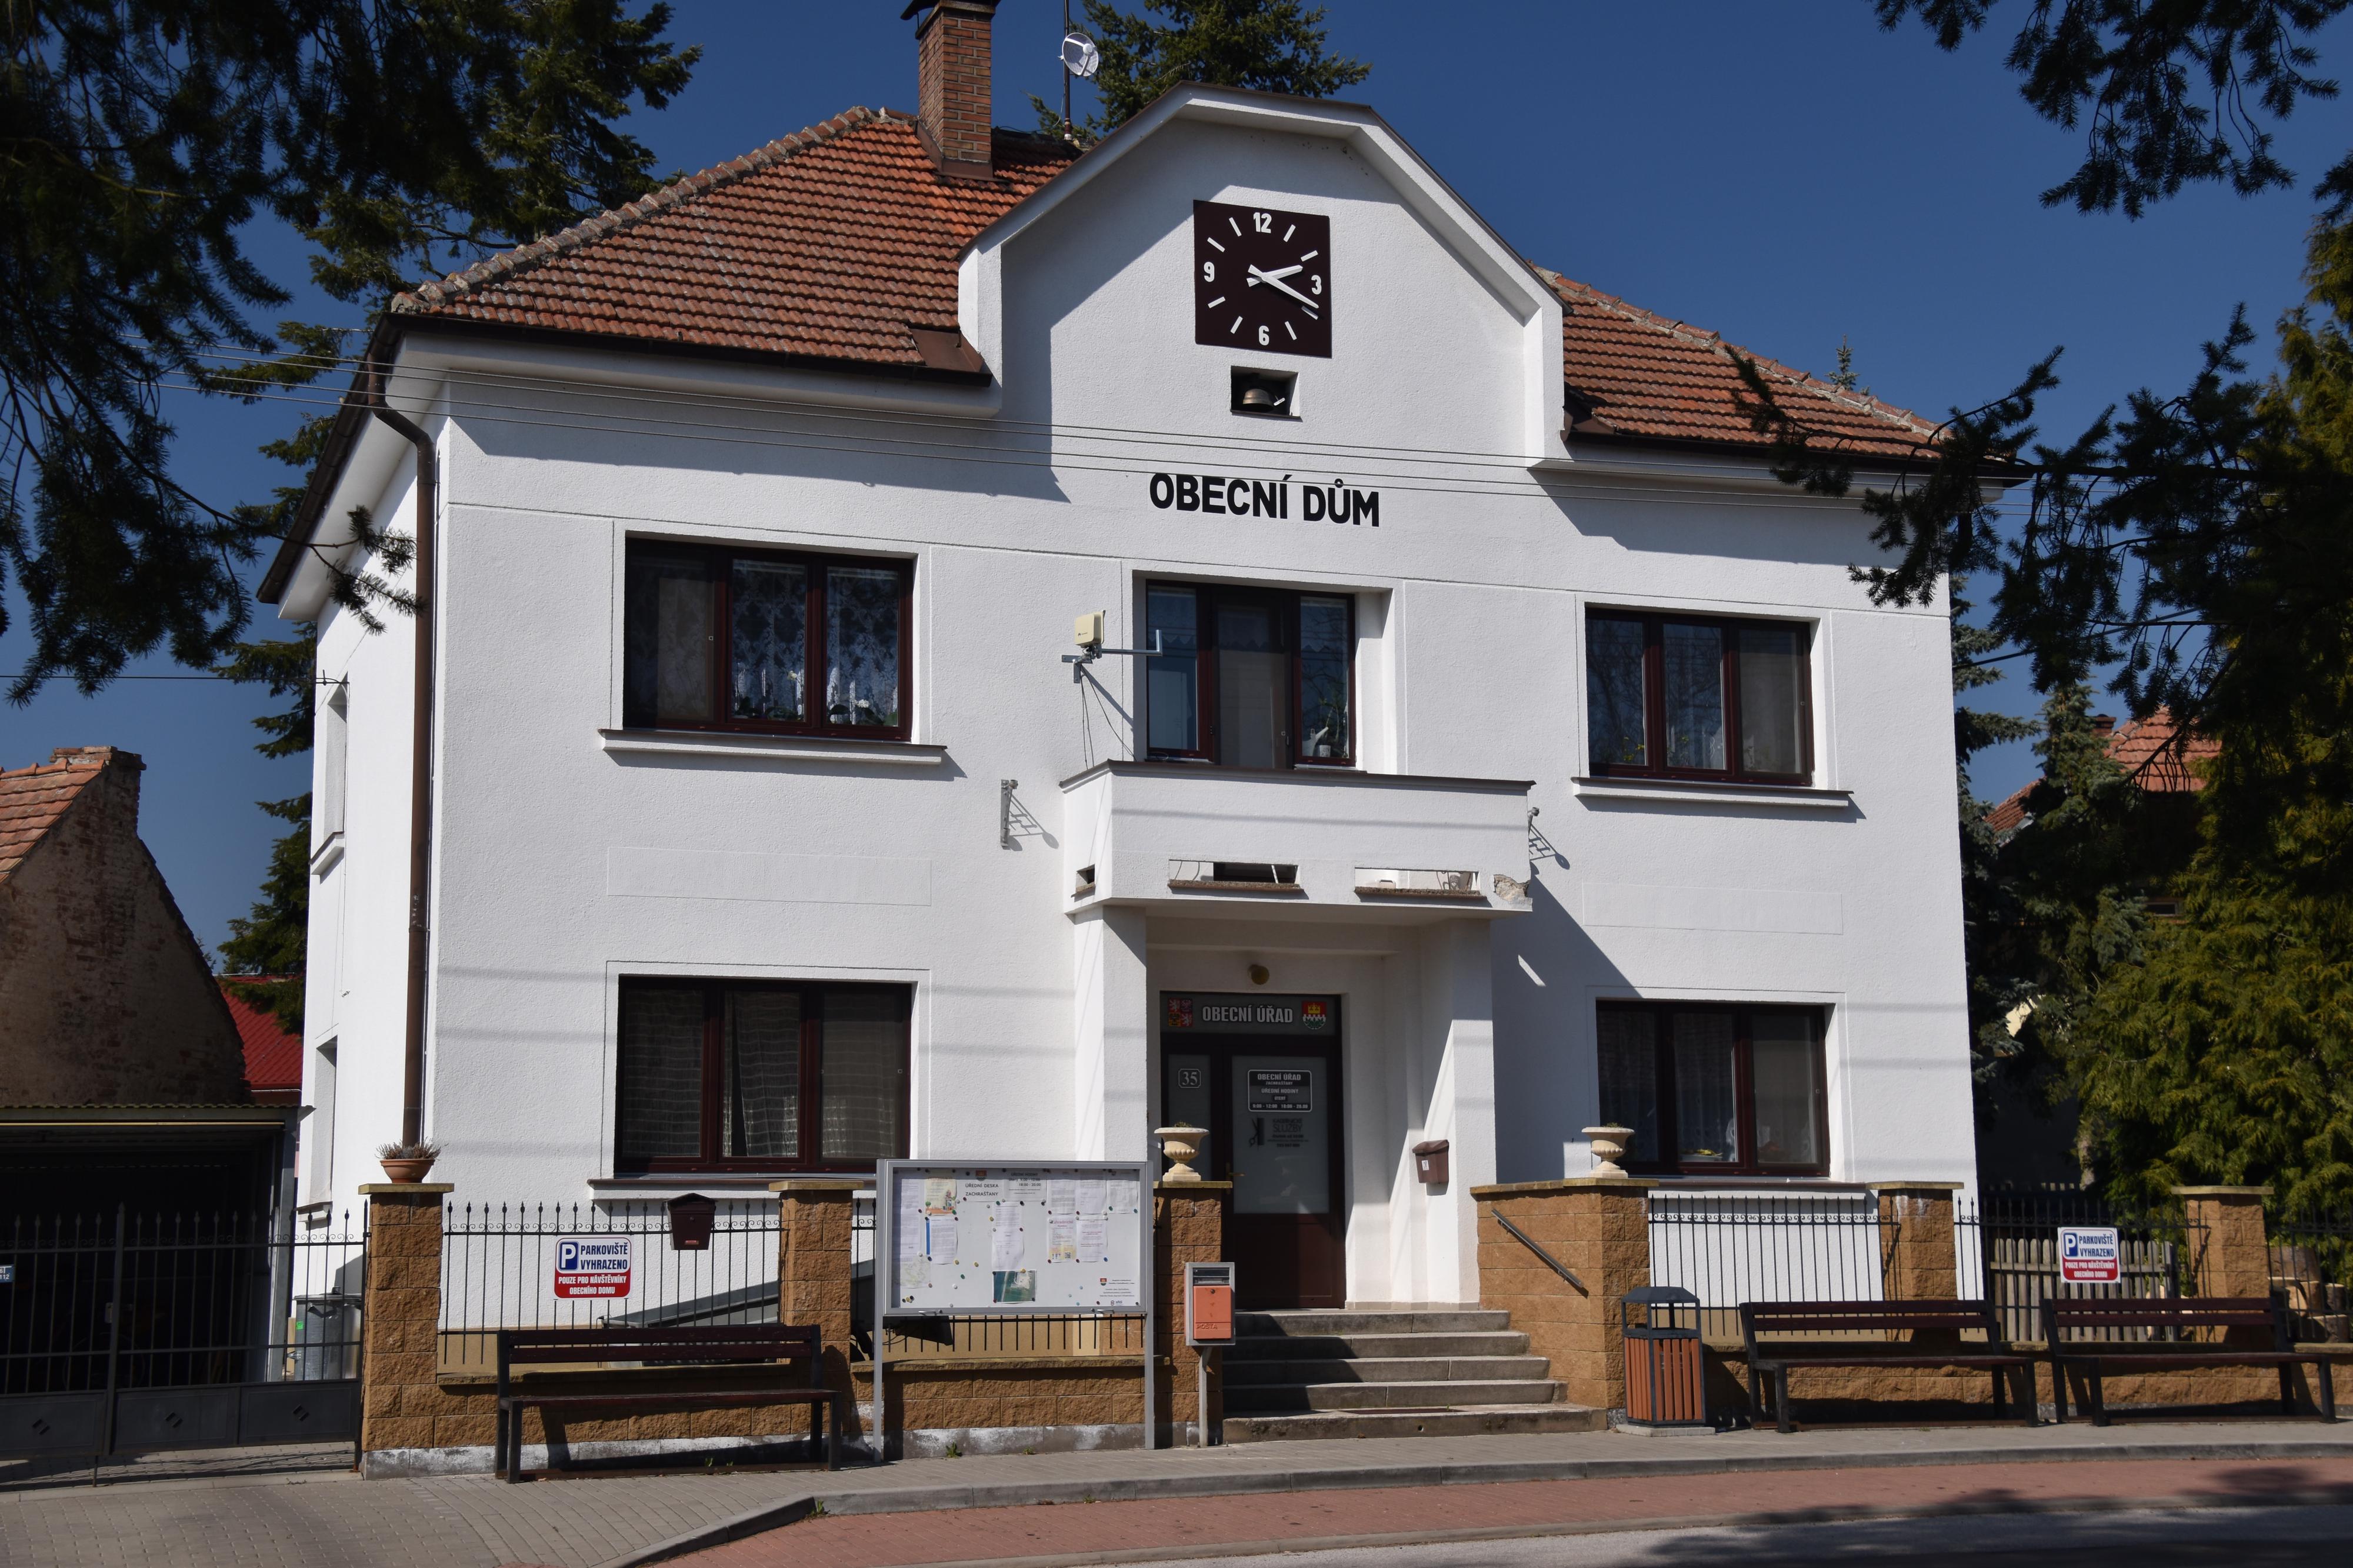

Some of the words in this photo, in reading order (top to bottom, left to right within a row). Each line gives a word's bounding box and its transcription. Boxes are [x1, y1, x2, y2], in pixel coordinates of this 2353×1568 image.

[1252, 212, 1272, 233] 12
[1204, 262, 1215, 282] 9
[1311, 275, 1322, 295] 3
[1258, 325, 1270, 346] 6
[1149, 473, 1292, 519] OBECNÍ
[1302, 478, 1379, 527] DŮM
[1202, 1005, 1252, 1022] OBECNÍ
[1256, 1005, 1293, 1023] ÚŘAD
[1181, 1071, 1198, 1086] 35
[1283, 1073, 1301, 1081] ÚŘAD
[2065, 1235, 2076, 1255] P
[2079, 1233, 2114, 1245] PARKOVIŠTĚ
[561, 1244, 576, 1268] P
[581, 1242, 628, 1255] PARKOVIŠTĚ
[2080, 1248, 2114, 1257] VYHRAZENO
[581, 1259, 628, 1270] VYHRAZENO
[590, 1274, 627, 1283] NÁVŠTĚVNÍKY
[569, 1285, 597, 1295] OBECNÍHO
